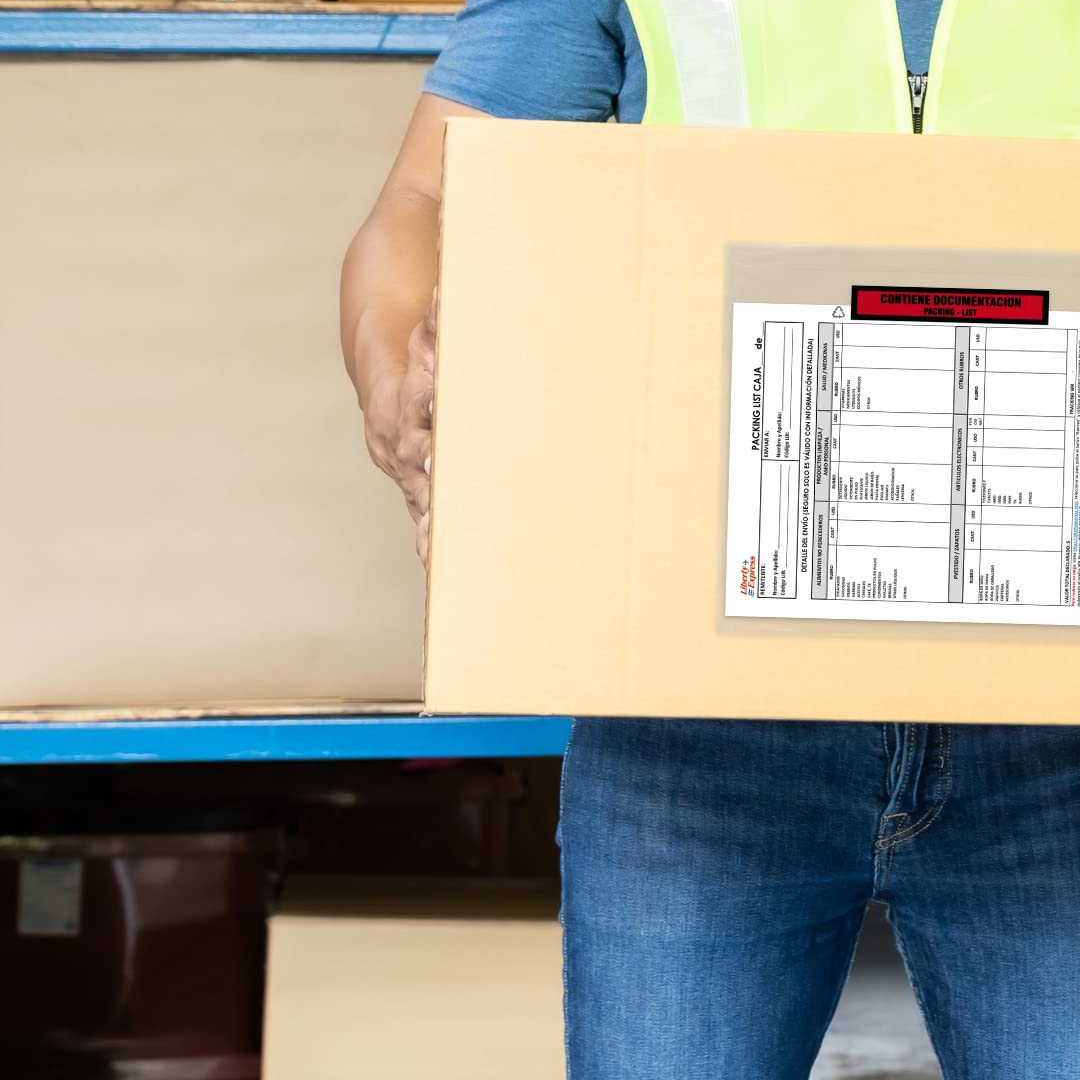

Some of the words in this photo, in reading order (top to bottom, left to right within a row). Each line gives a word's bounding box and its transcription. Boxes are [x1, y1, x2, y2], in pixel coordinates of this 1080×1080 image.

[880, 294, 931, 306] CONTIENE
[933, 295, 1022, 308] DOCUMENTACION
[923, 308, 955, 316] PACKING
[962, 309, 977, 317] LIST
[754, 338, 763, 349] de
[753, 366, 762, 391] CAJA
[753, 393, 761, 407] LIST
[804, 376, 812, 419] INFORMACIÓN
[752, 410, 761, 450] PACKING
[803, 438, 811, 460] VÁLIDO
[801, 517, 809, 535] ENVÍO
[817, 549, 822, 557] NO
[740, 566, 749, 595] Liberty
[748, 556, 757, 589] Express
